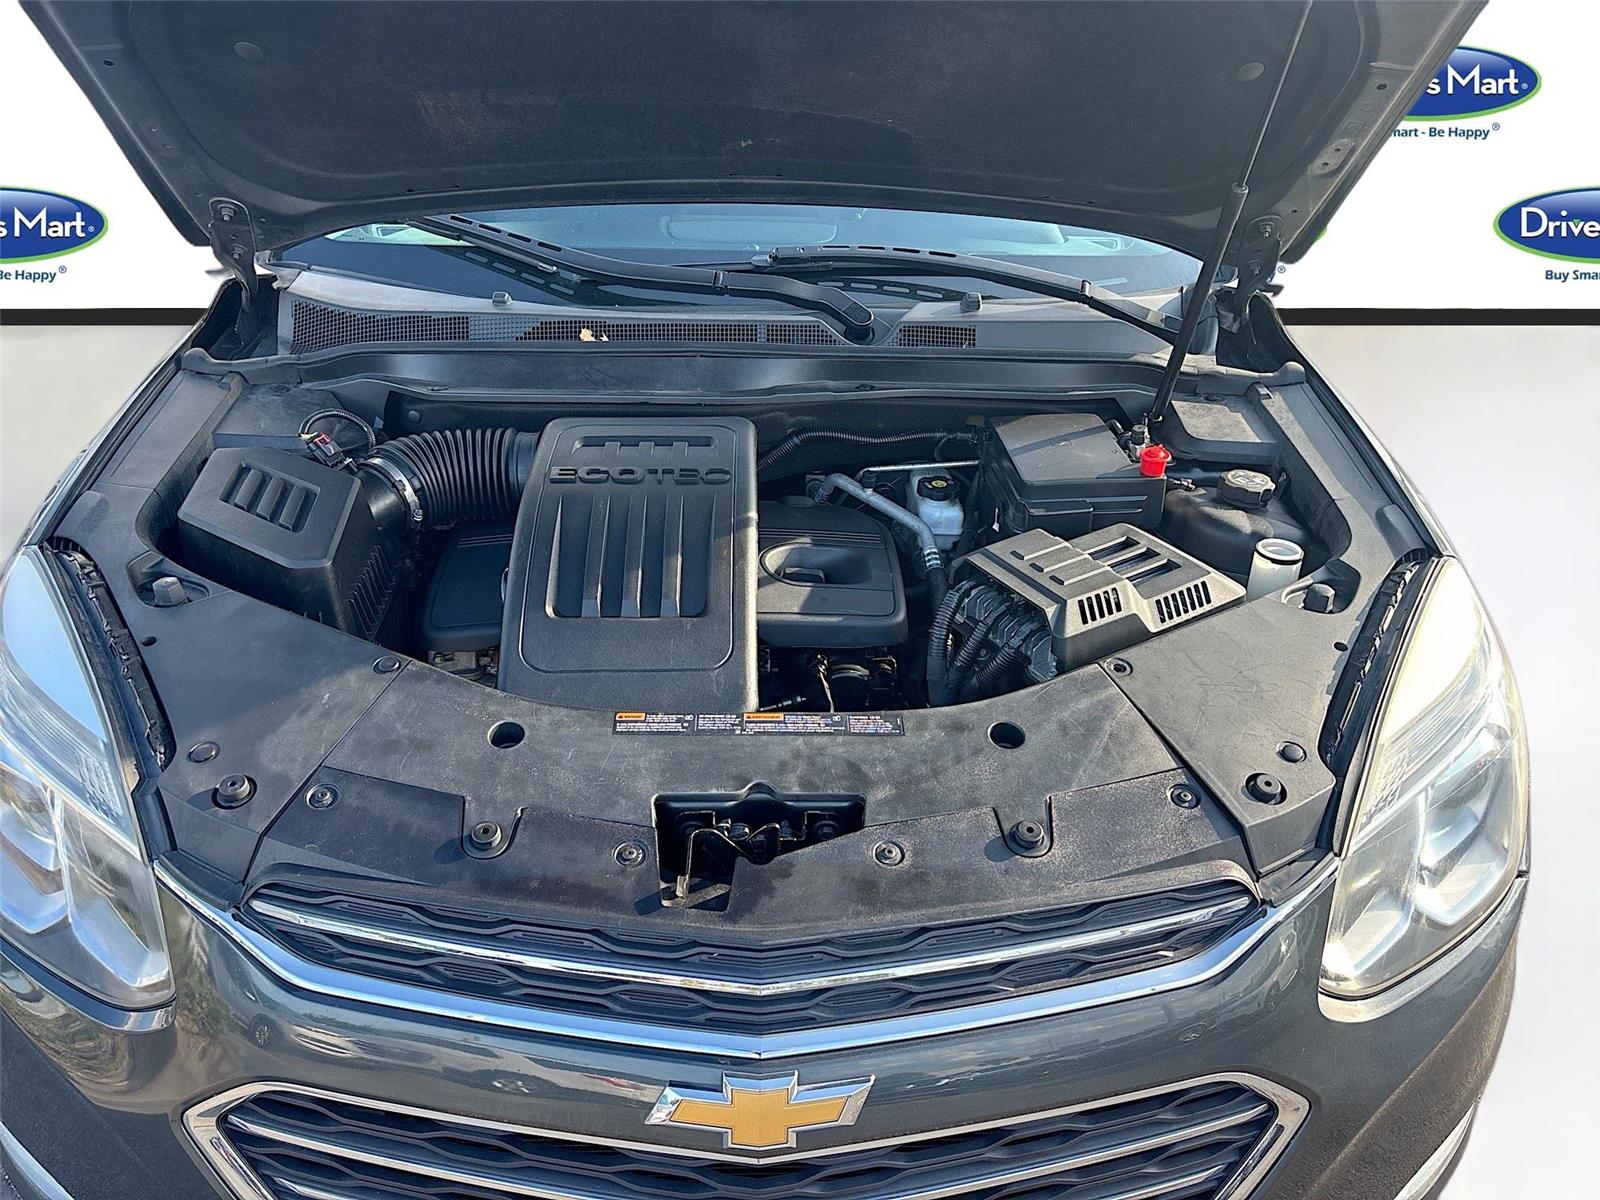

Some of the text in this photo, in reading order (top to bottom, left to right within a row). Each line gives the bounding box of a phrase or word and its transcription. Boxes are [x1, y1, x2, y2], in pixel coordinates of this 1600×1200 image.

[1447, 64, 1519, 95] Mart
[1391, 128, 1419, 138] mart
[1428, 126, 1445, 138] Be
[1448, 126, 1490, 140] Happy
[14, 206, 86, 238] Mart
[15, 270, 57, 283] Happy
[1545, 269, 1600, 283] Buy Sma
[550, 466, 732, 485] ECOTEC
